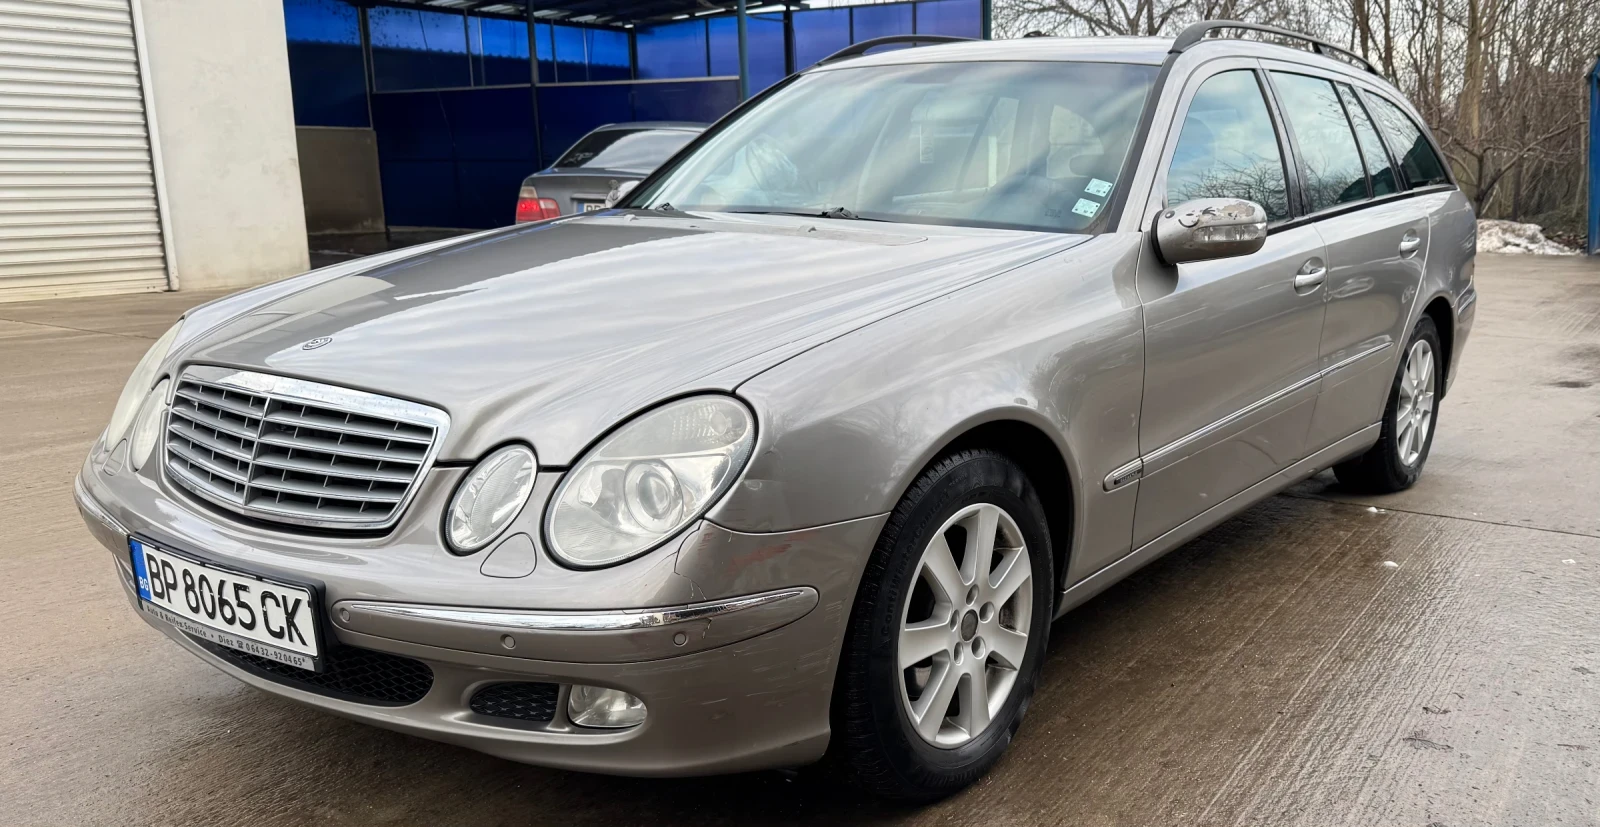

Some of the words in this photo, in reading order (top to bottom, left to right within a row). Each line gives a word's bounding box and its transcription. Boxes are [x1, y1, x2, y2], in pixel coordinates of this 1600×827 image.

[139, 576, 149, 591] BG
[146, 552, 178, 603] BP
[182, 568, 256, 631] 8065
[260, 590, 308, 646] CK
[146, 605, 159, 617] Auto
[159, 611, 164, 620] &
[218, 634, 234, 646] Diez
